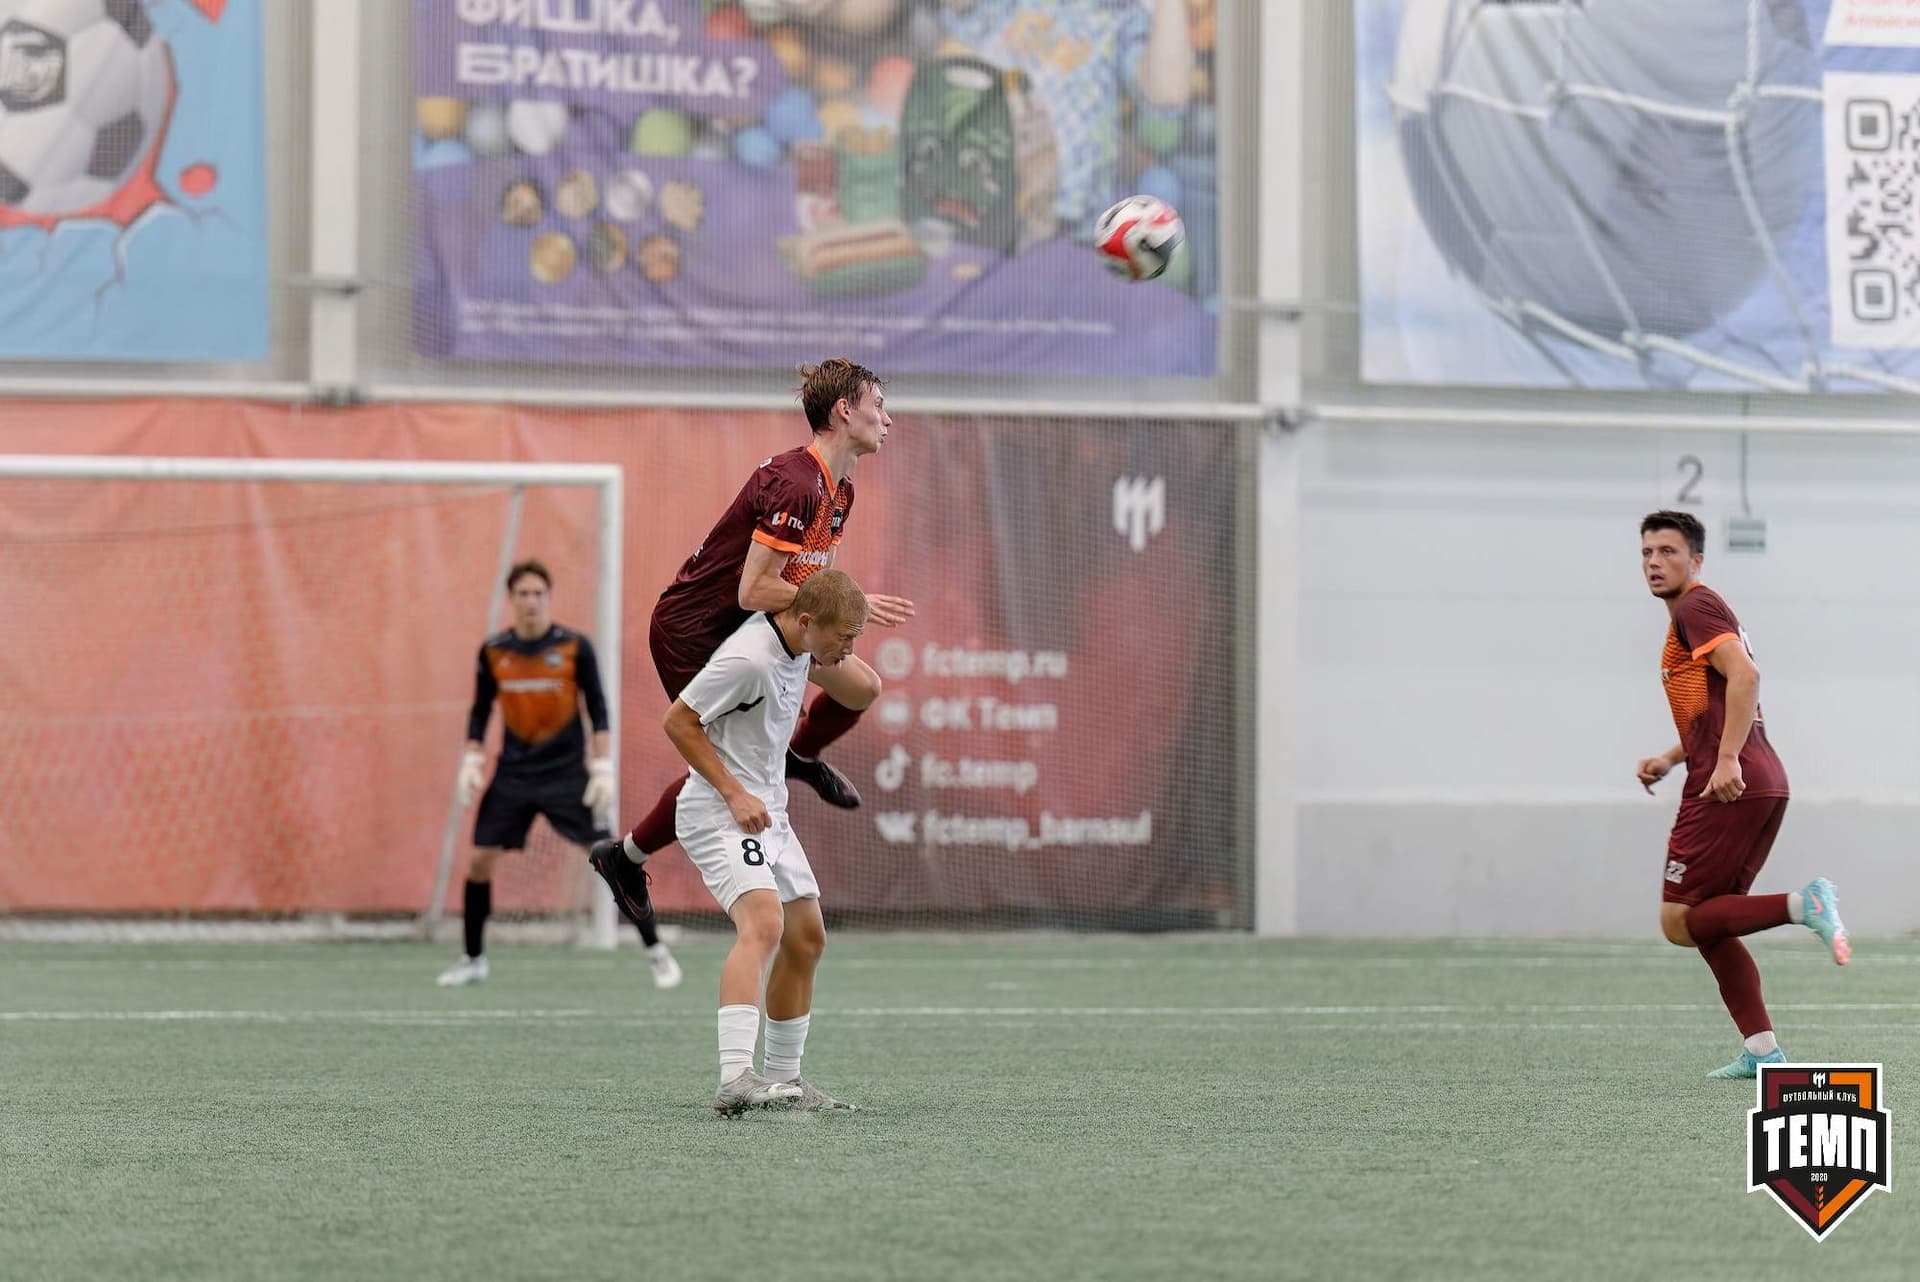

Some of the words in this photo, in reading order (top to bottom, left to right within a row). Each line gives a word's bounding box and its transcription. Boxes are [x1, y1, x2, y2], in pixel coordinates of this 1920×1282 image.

[456, 43, 758, 98] БРАТИШКА?
[1677, 454, 1704, 505] 2
[922, 641, 1068, 684] fctemp.ru
[920, 752, 1038, 794] fc.temp
